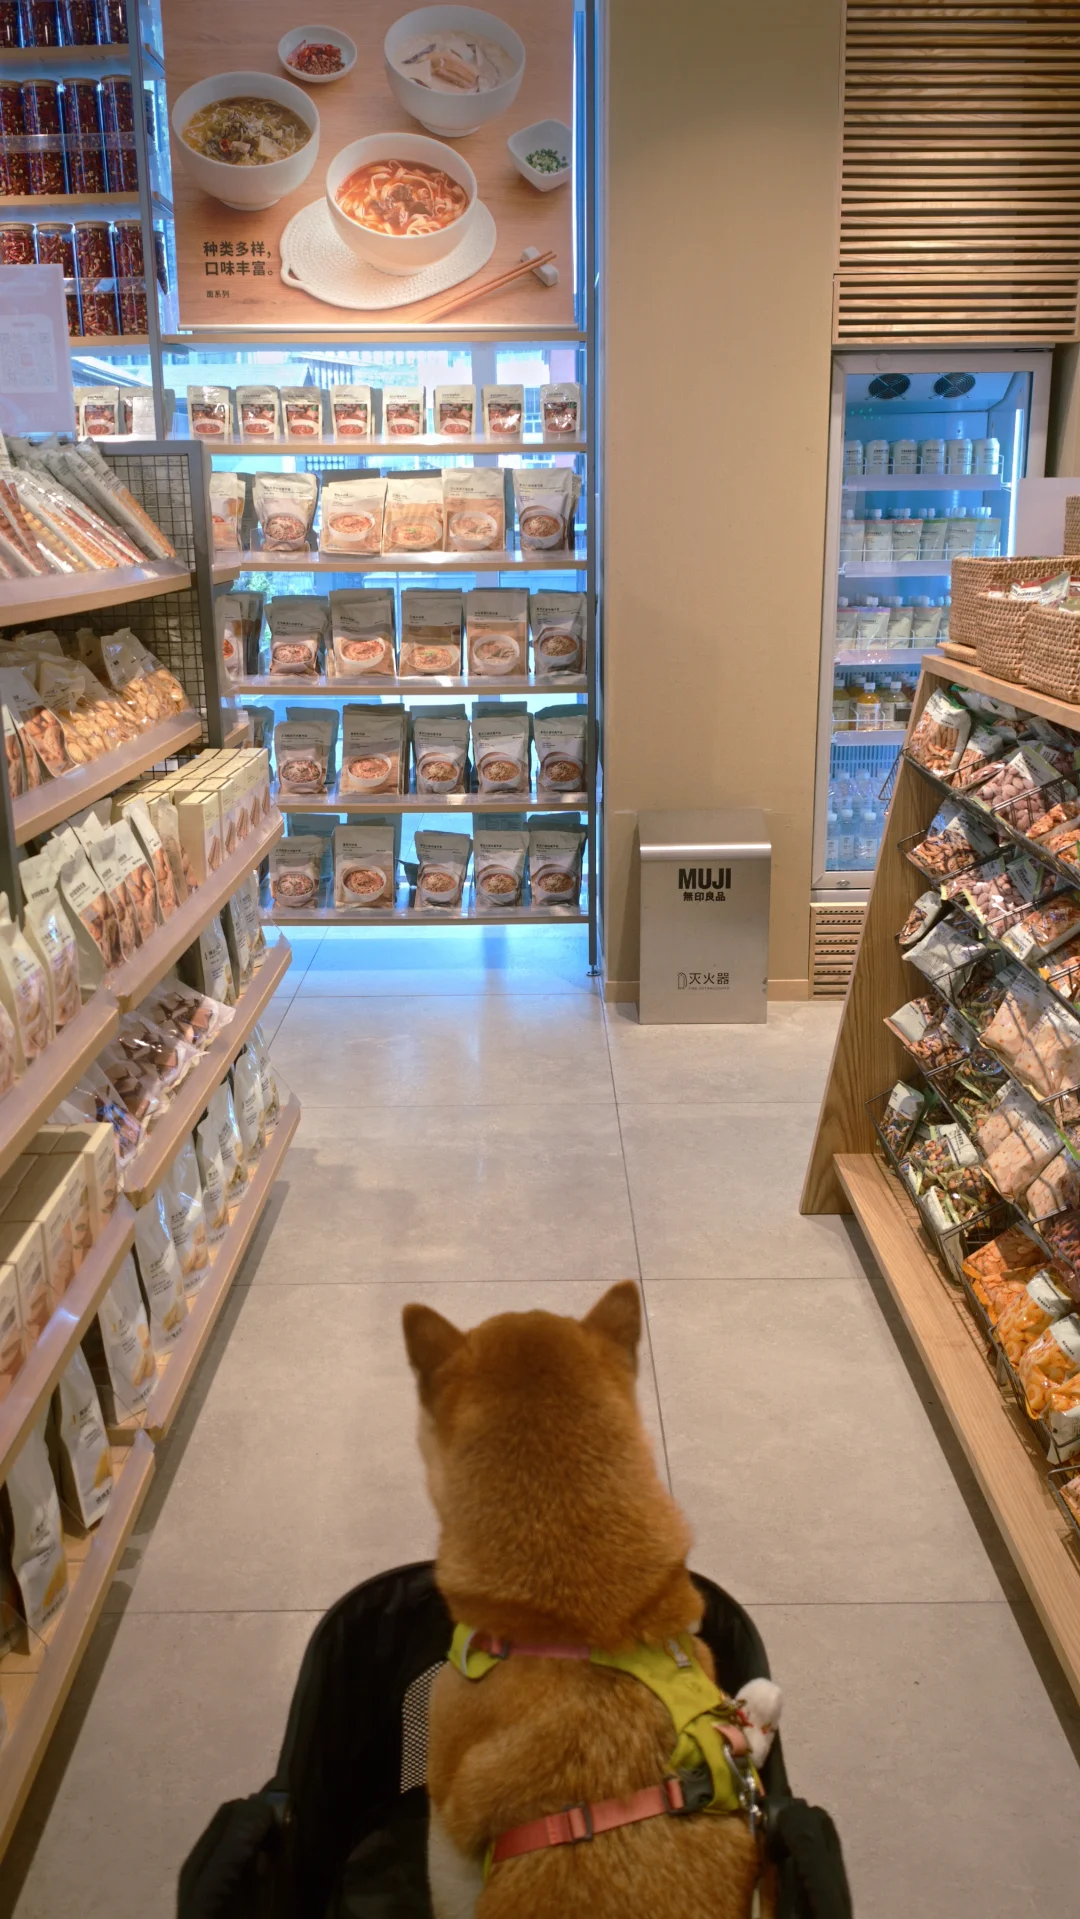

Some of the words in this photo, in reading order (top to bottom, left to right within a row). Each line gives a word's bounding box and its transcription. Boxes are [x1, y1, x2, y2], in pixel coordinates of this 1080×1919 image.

[203, 241, 272, 258] 种类多样，
[205, 260, 273, 276] 口味丰富。
[678, 868, 732, 890] MUJI
[683, 891, 726, 902] 無印良品
[689, 972, 730, 985] 灭火器
